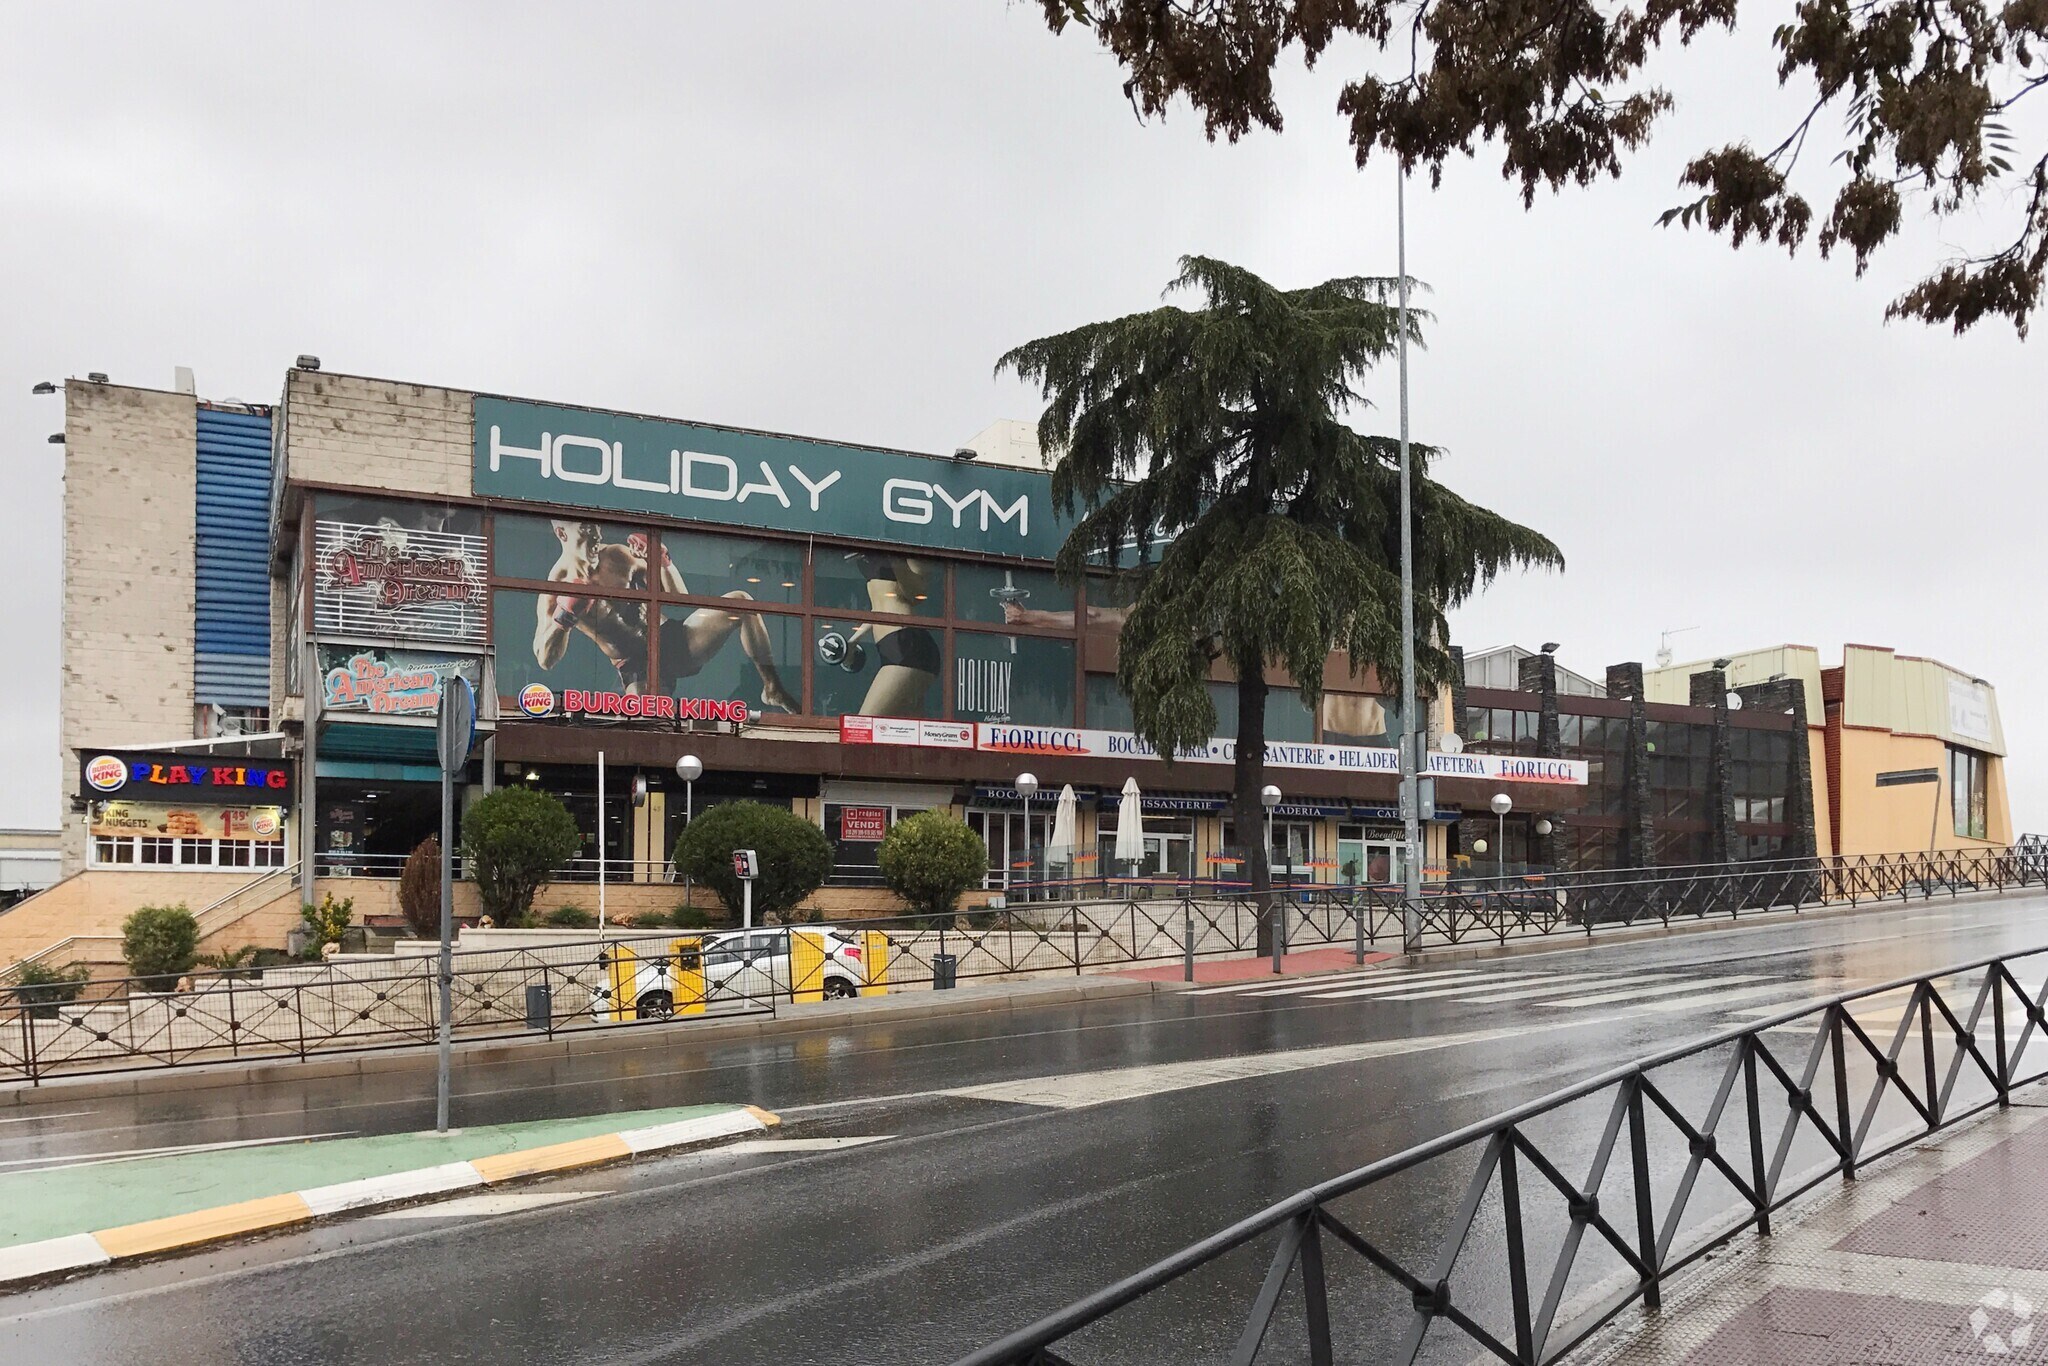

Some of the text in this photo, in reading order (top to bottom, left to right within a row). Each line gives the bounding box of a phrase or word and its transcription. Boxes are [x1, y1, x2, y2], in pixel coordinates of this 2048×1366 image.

[489, 425, 842, 512] HOLIDAY
[883, 478, 1029, 536] GYM
[353, 657, 385, 679] The
[328, 672, 435, 702] American
[523, 691, 552, 699] BURGER
[957, 657, 1012, 714] HOLIDAY
[372, 691, 440, 713] Dream
[524, 697, 552, 707] KING
[564, 689, 748, 722] BURGER KING
[92, 764, 122, 774] BURGER
[1338, 750, 1398, 769] HELADER
[1427, 757, 1485, 775] AFETERiA
[92, 770, 122, 783] KING
[131, 762, 288, 788] PLAY KING
[105, 808, 129, 818] KING
[1116, 799, 1213, 811] CISSANTERIE
[847, 820, 881, 829] VENDE
